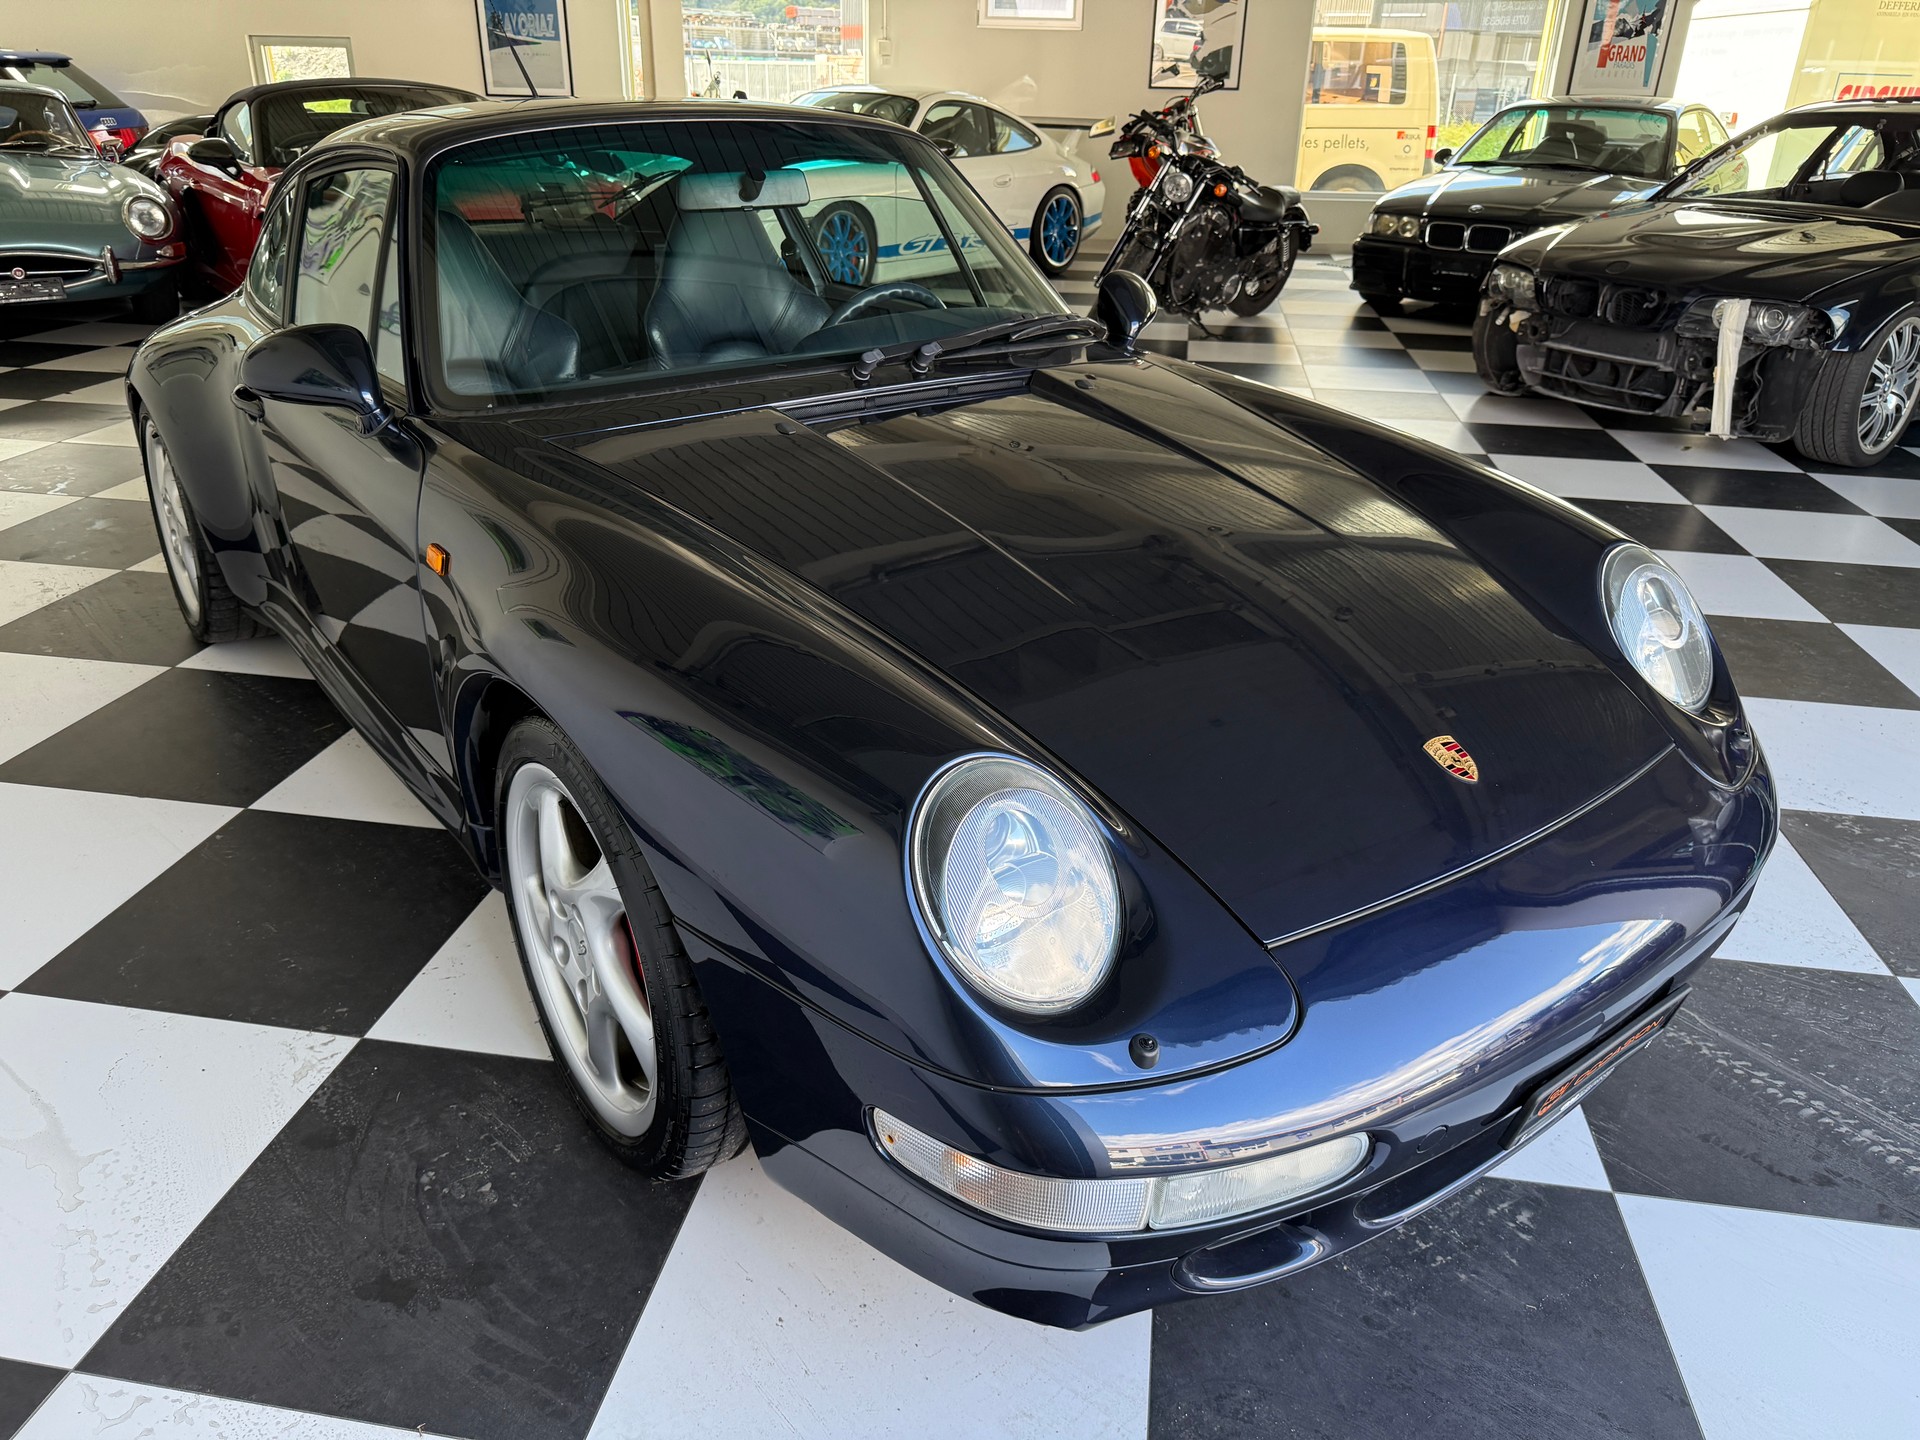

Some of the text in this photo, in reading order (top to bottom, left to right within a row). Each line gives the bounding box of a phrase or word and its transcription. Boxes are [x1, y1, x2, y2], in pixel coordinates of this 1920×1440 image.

[504, 12, 555, 37] AVORIAZ
[1608, 44, 1647, 62] GRAND
[1323, 134, 1370, 152] pellets,
[566, 760, 620, 855] MICHELIN
